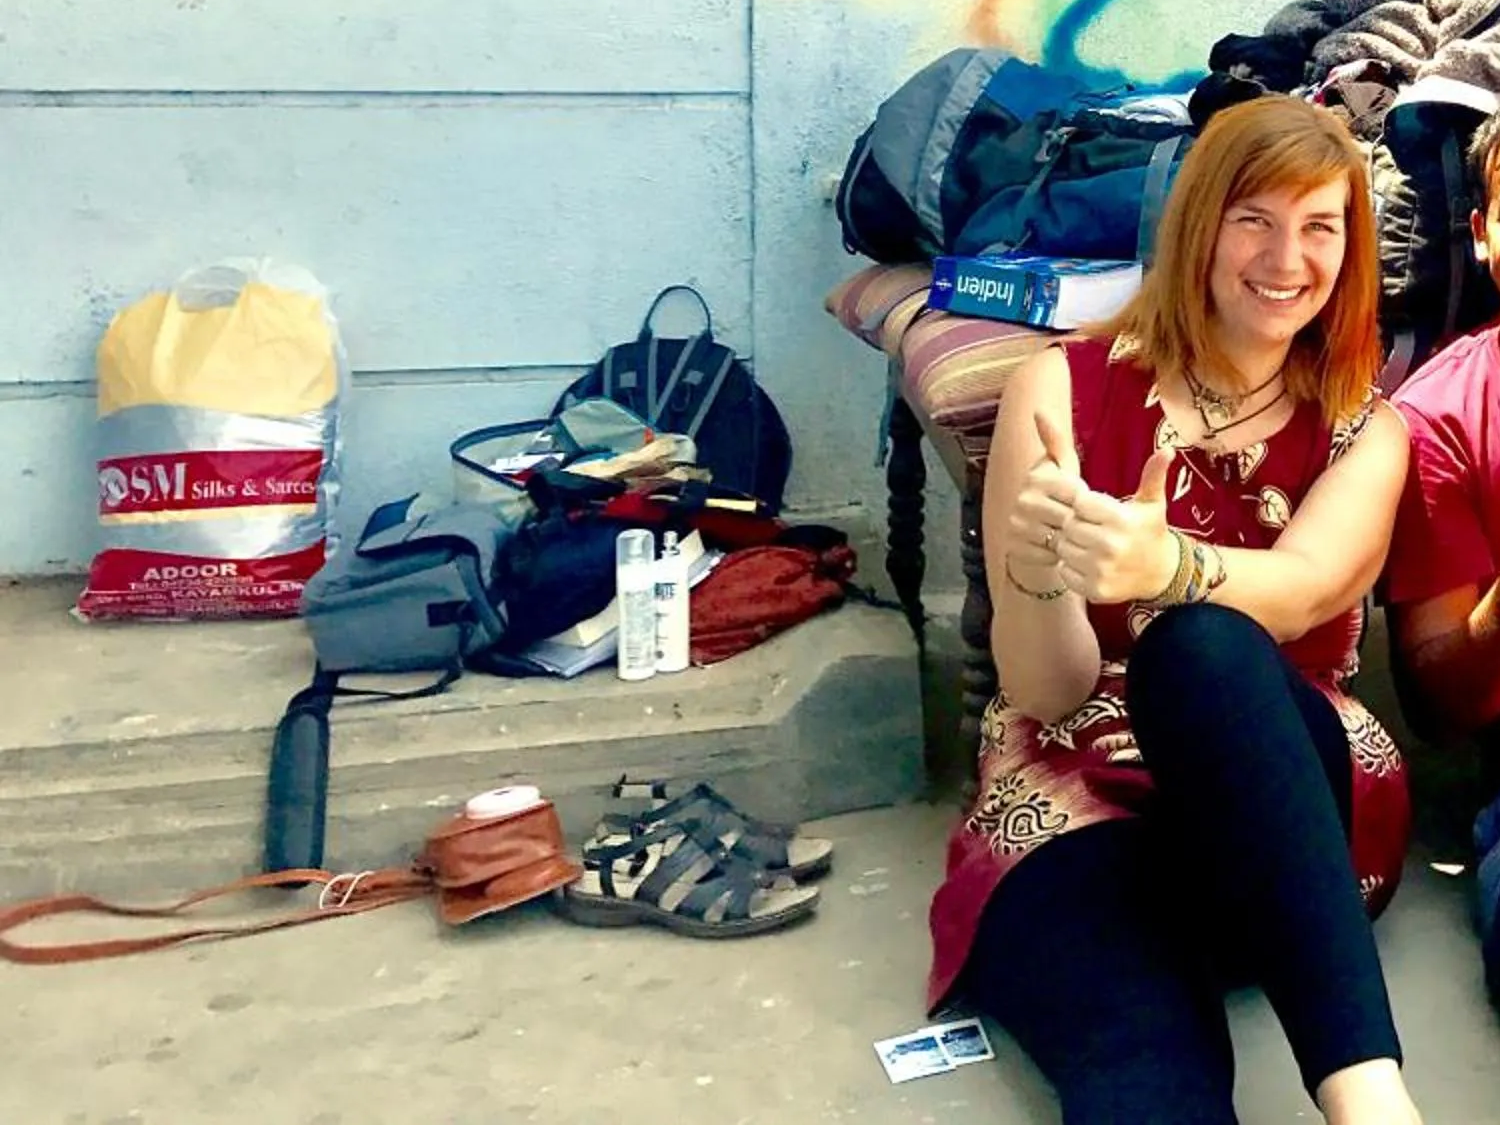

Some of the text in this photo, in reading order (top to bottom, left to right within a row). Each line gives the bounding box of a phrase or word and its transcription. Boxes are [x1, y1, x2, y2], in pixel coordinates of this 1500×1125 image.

[957, 274, 1015, 307] Indien
[192, 479, 236, 501] Silks
[242, 478, 259, 497] &
[143, 563, 238, 581] ADOOR
